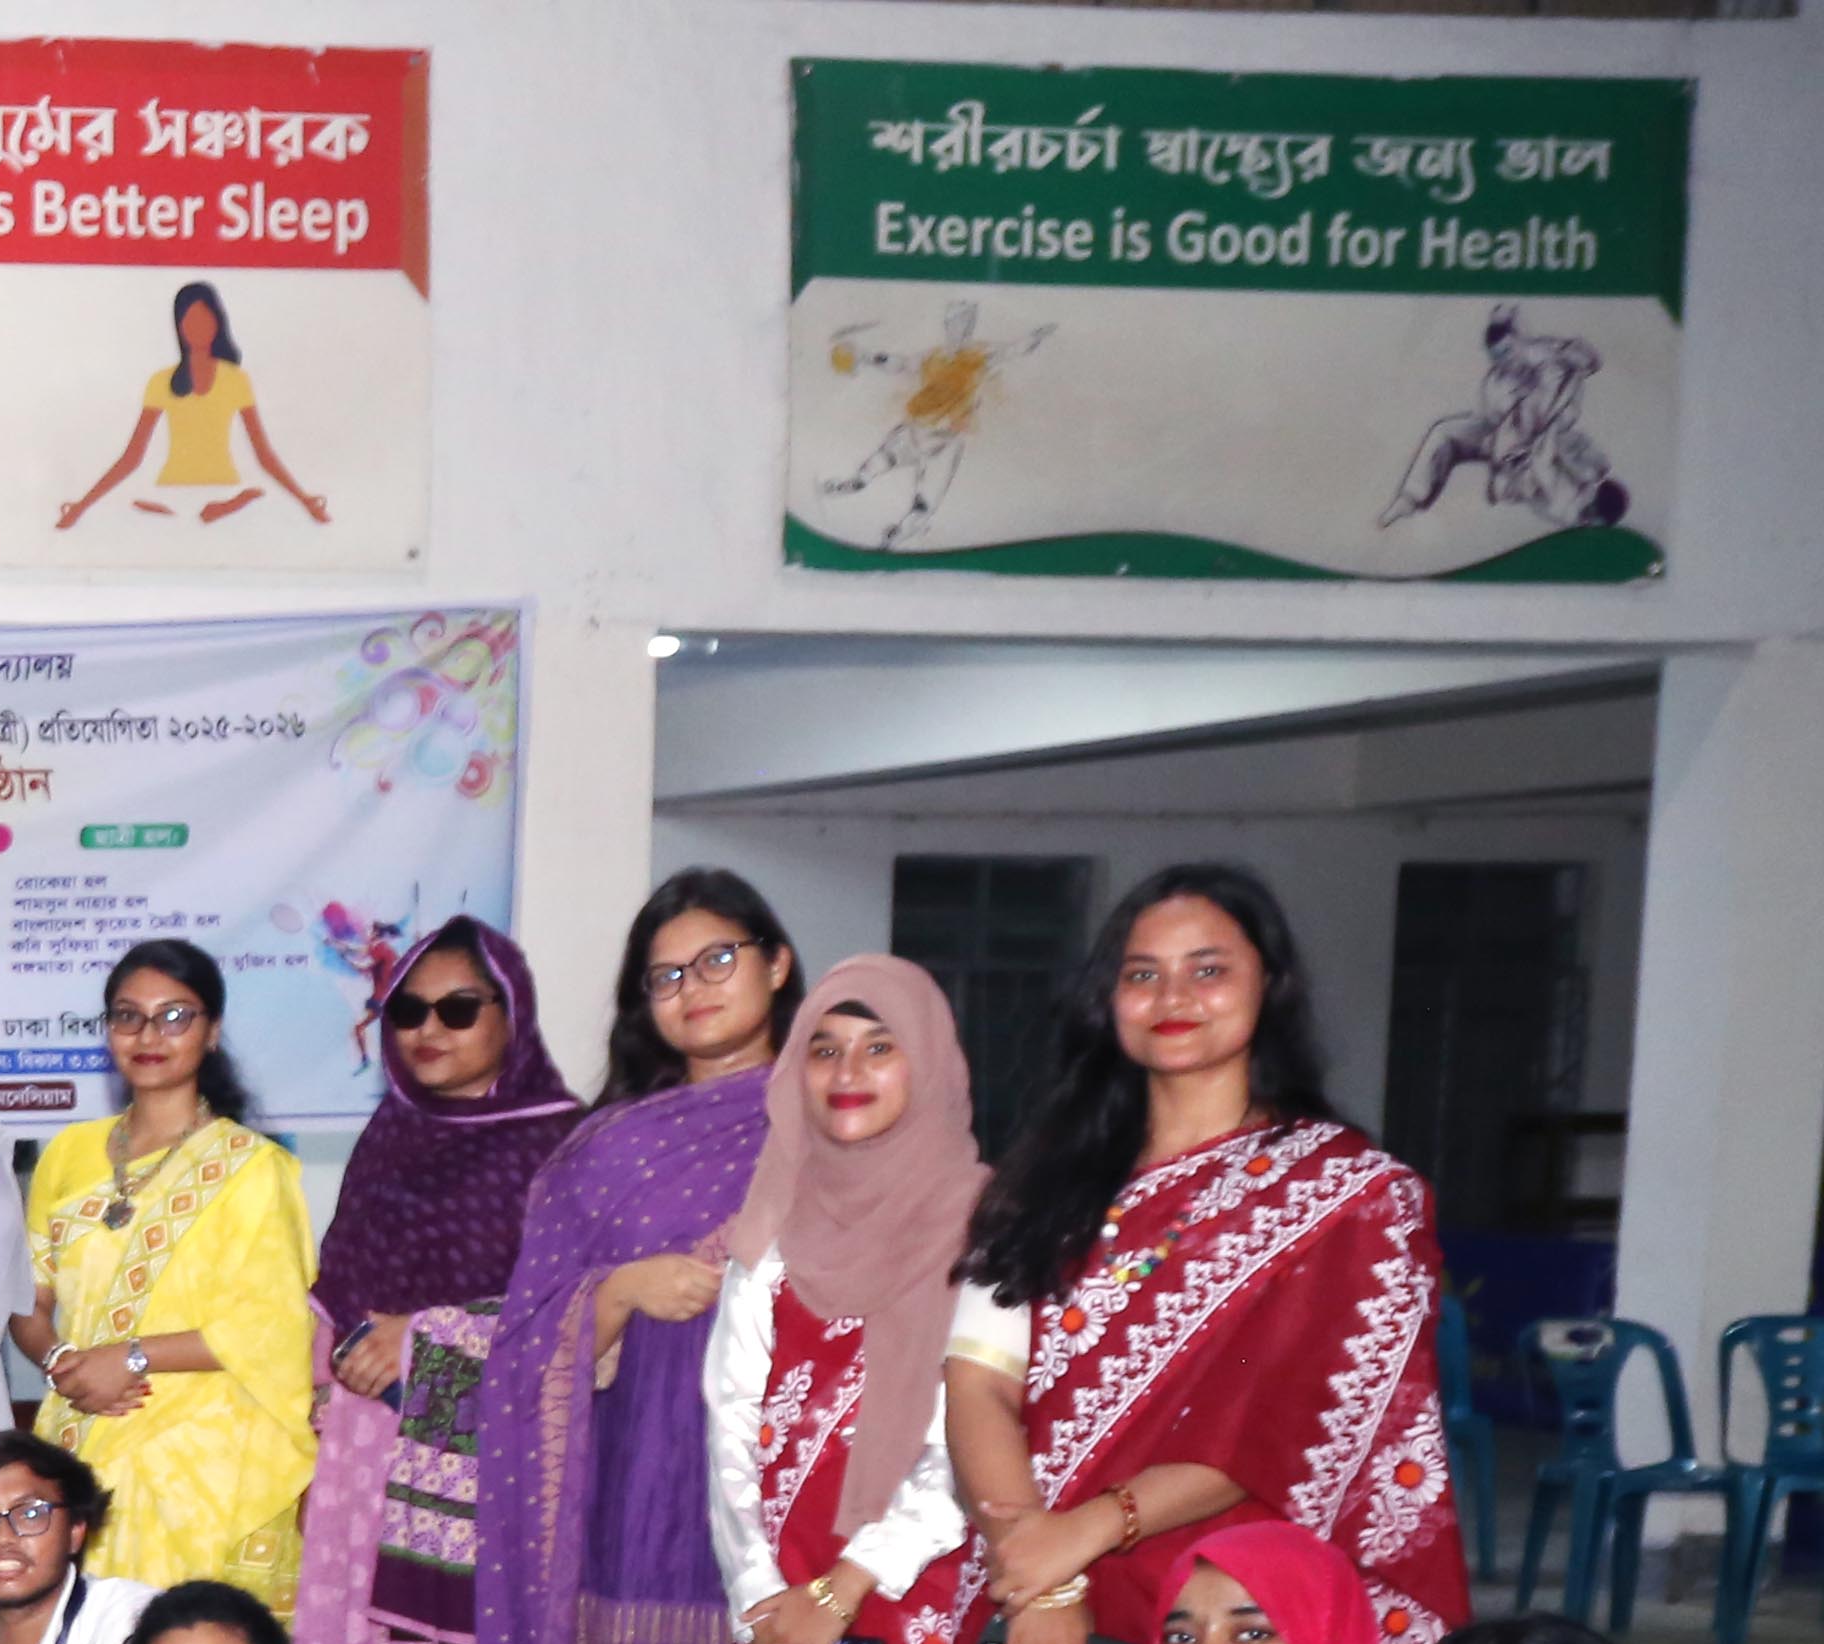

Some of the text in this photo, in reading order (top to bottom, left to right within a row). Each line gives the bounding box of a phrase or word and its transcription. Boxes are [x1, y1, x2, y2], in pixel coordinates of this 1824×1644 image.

[138, 98, 371, 168] সঞ্চারক
[868, 100, 1121, 173] শরীরচর্চা
[1353, 134, 1476, 202] জন্য
[1494, 135, 1614, 183] ভাল
[32, 179, 205, 240] Better
[218, 181, 370, 255] Sleep
[875, 201, 1598, 270] Exercise is Good for Health
[38, 708, 160, 745] প্রতিযোগিতা
[168, 712, 306, 744] ২০২৫-২০২৬
[3, 1017, 51, 1039] ঢাকা
